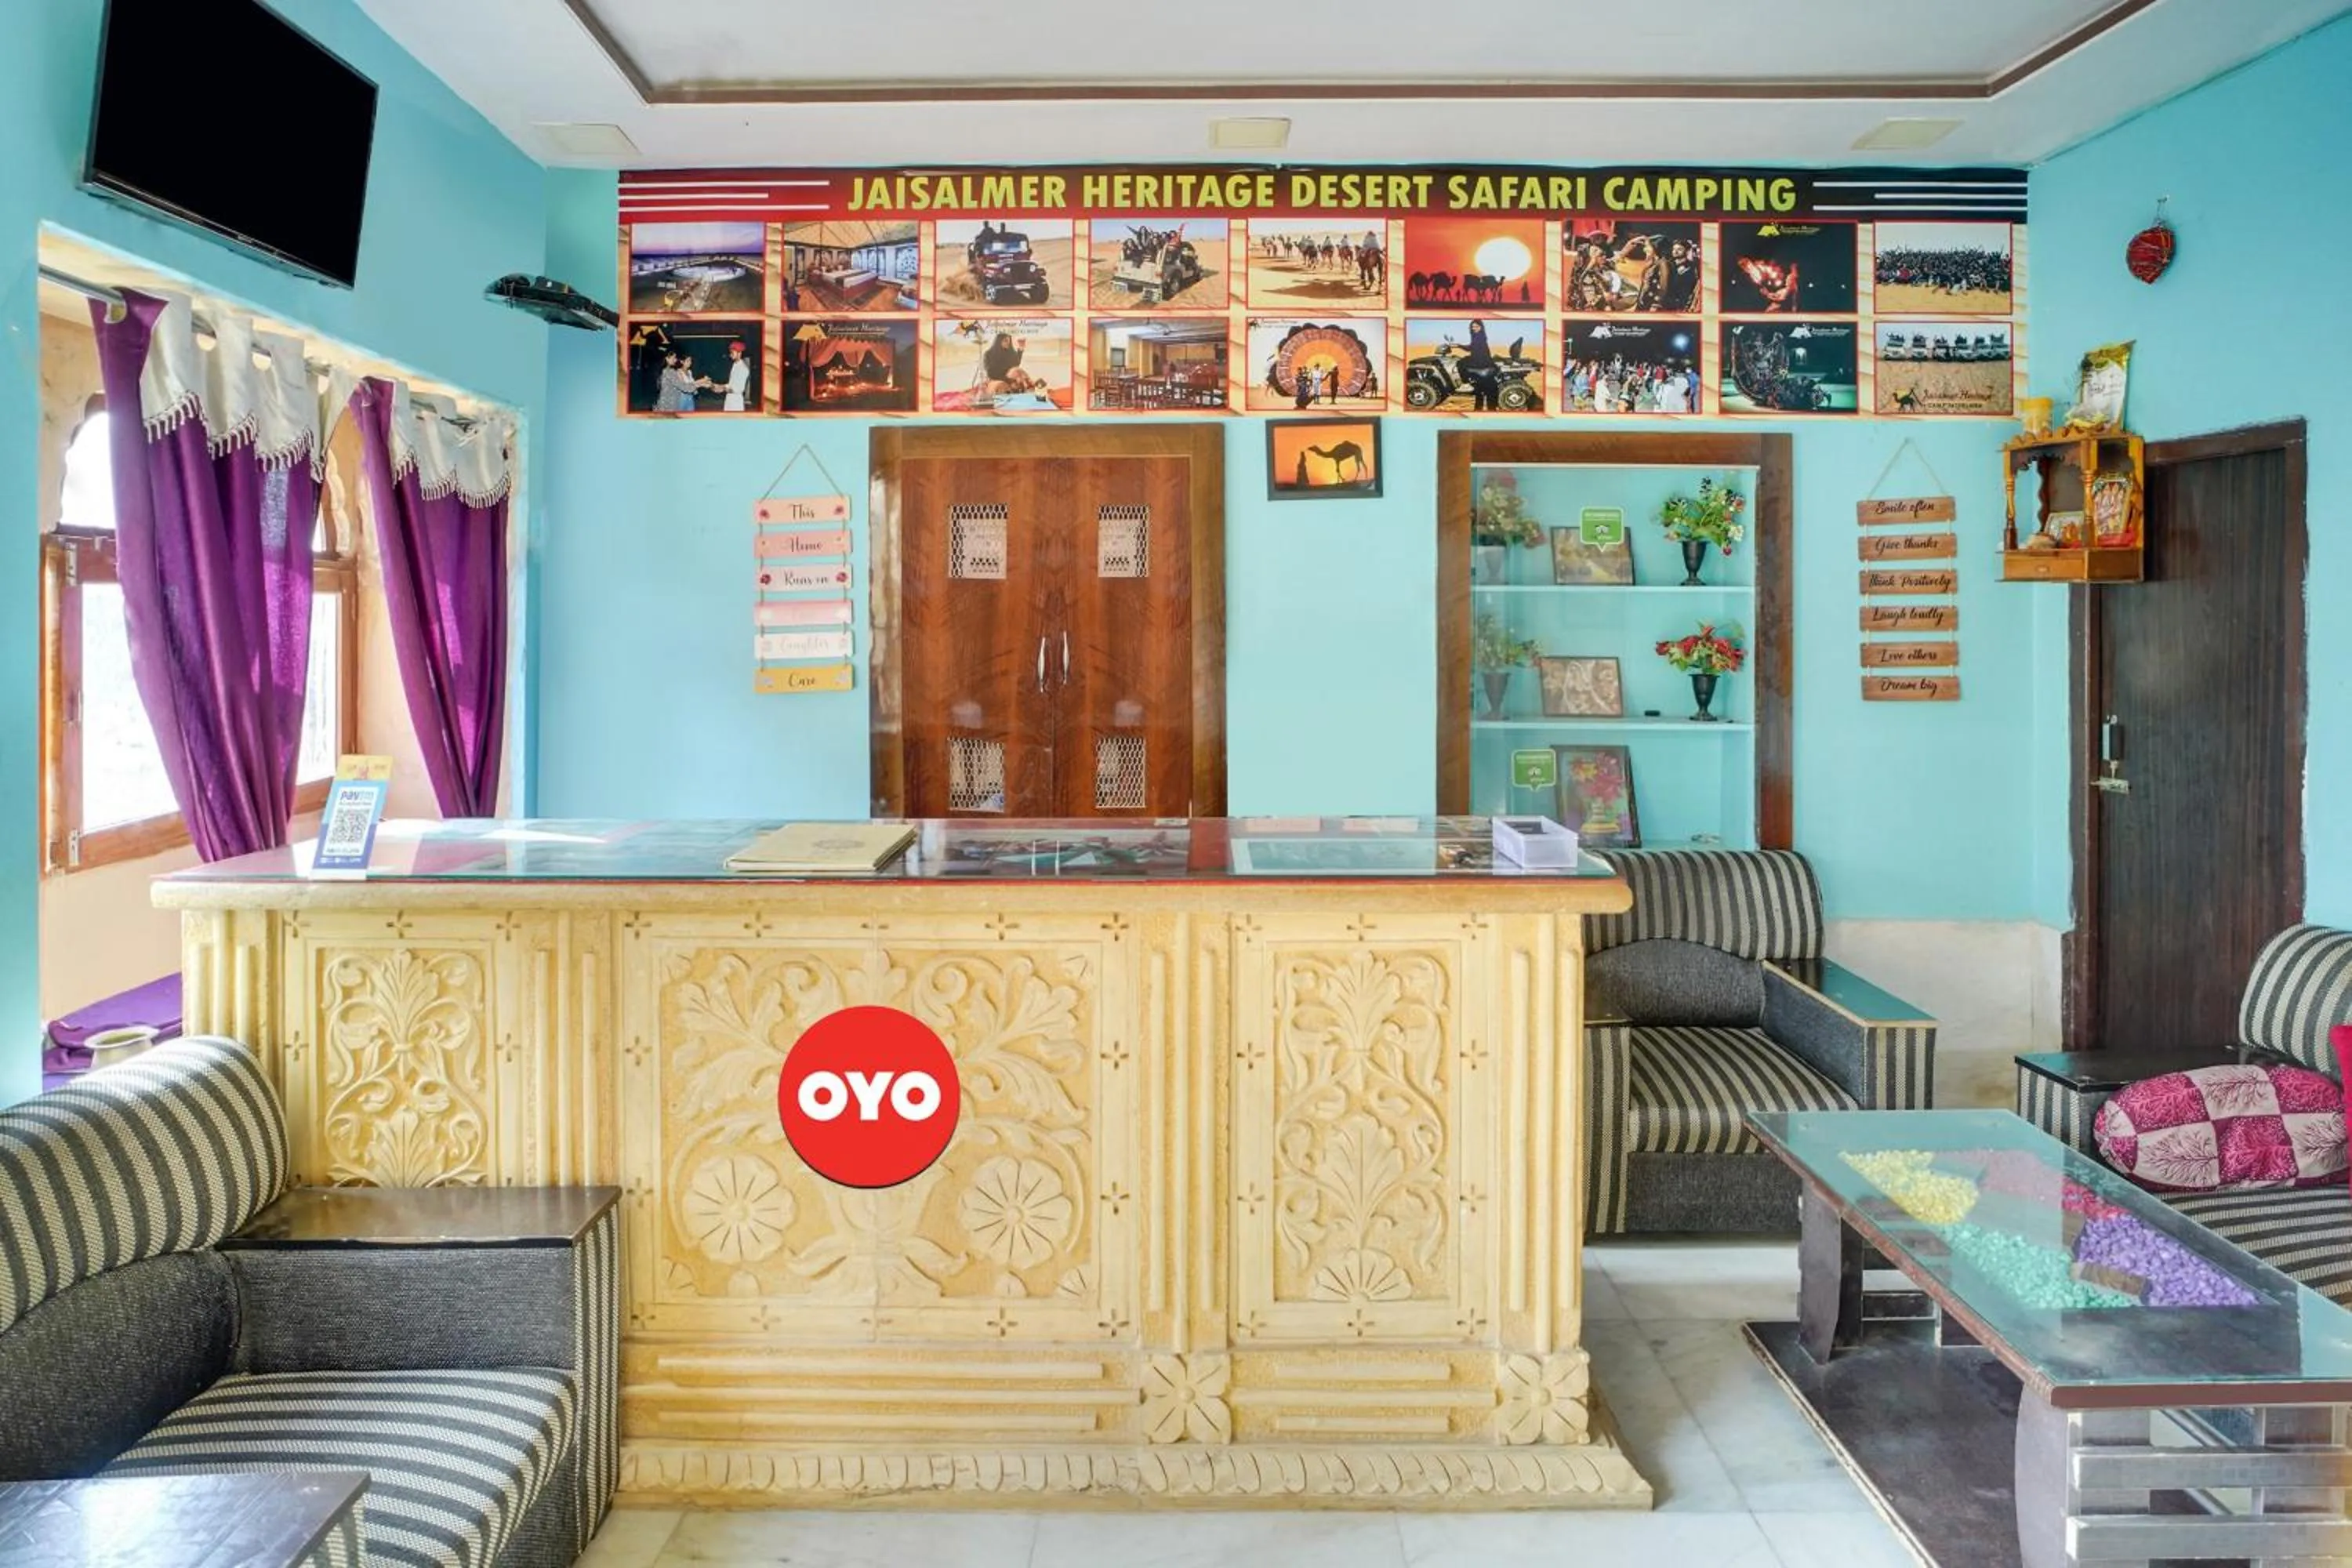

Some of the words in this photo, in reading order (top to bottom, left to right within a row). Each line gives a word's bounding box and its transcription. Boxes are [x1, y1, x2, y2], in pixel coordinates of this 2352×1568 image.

[848, 175, 1067, 211] JAISALMER
[1082, 174, 1275, 209] HERITAGE
[1290, 175, 1433, 209] DESERT
[1447, 175, 1587, 210] SAFARI
[1602, 177, 1797, 212] CAMPING
[789, 503, 815, 520] This
[1875, 501, 1906, 514] Smile
[1908, 499, 1935, 518] often
[1875, 538, 1900, 555] Give
[1903, 536, 1938, 549] thanks
[1871, 607, 1907, 626] Laugh
[1909, 607, 1944, 626] loudly
[1880, 648, 1903, 662] Love
[1907, 648, 1938, 660] others
[788, 671, 815, 687] Care
[1881, 677, 1917, 691] Dream
[1919, 677, 1938, 698] big
[797, 1070, 942, 1122] OYO
